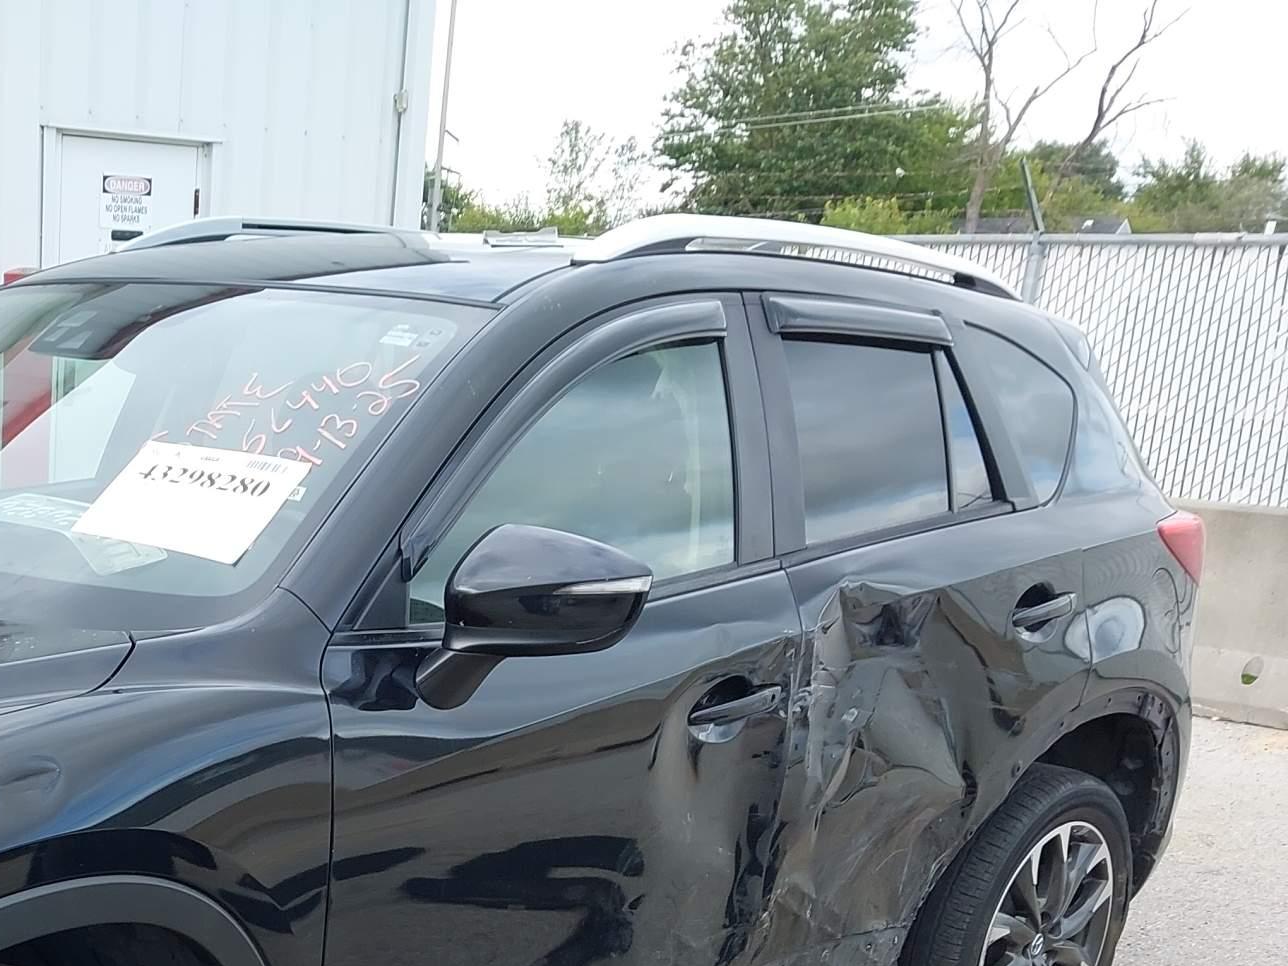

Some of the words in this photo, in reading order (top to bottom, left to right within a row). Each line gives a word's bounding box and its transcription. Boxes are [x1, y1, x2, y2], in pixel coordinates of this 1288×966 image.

[109, 180, 145, 192] DANGER
[112, 195, 119, 203] NO
[120, 195, 143, 205] SMOKING
[105, 204, 113, 212] NO
[114, 205, 127, 213] OPEN
[128, 205, 148, 214] FLAMES
[113, 213, 120, 222] NO
[121, 214, 140, 223] SPARKS
[138, 464, 271, 497] 43298280
